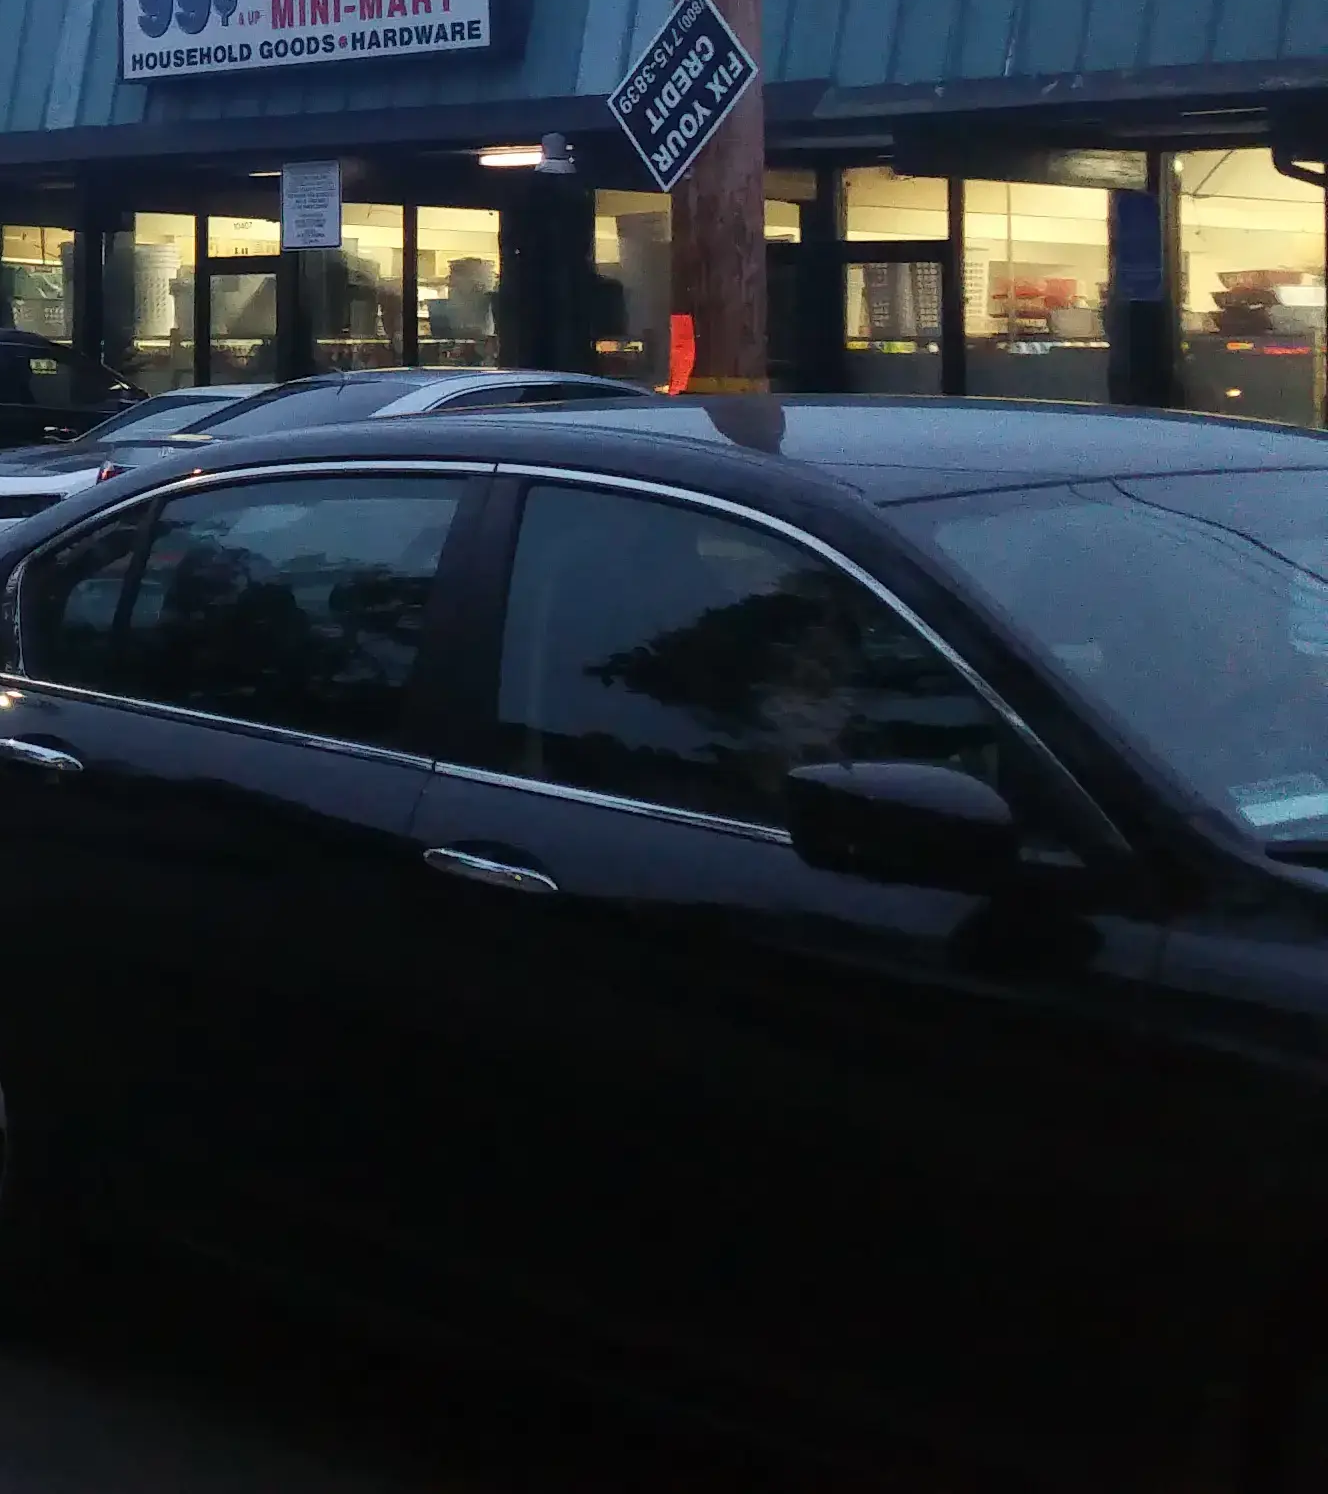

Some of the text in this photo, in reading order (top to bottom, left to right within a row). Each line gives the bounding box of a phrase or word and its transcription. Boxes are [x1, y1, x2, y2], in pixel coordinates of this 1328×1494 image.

[131, 42, 252, 72] HOUSEHOLD
[259, 34, 335, 59] GOODS
[351, 19, 482, 51] HARDWARE
[618, 28, 684, 114] 715-3839
[645, 34, 715, 135] CREDIT
[650, 50, 744, 173] FIX YOUR
